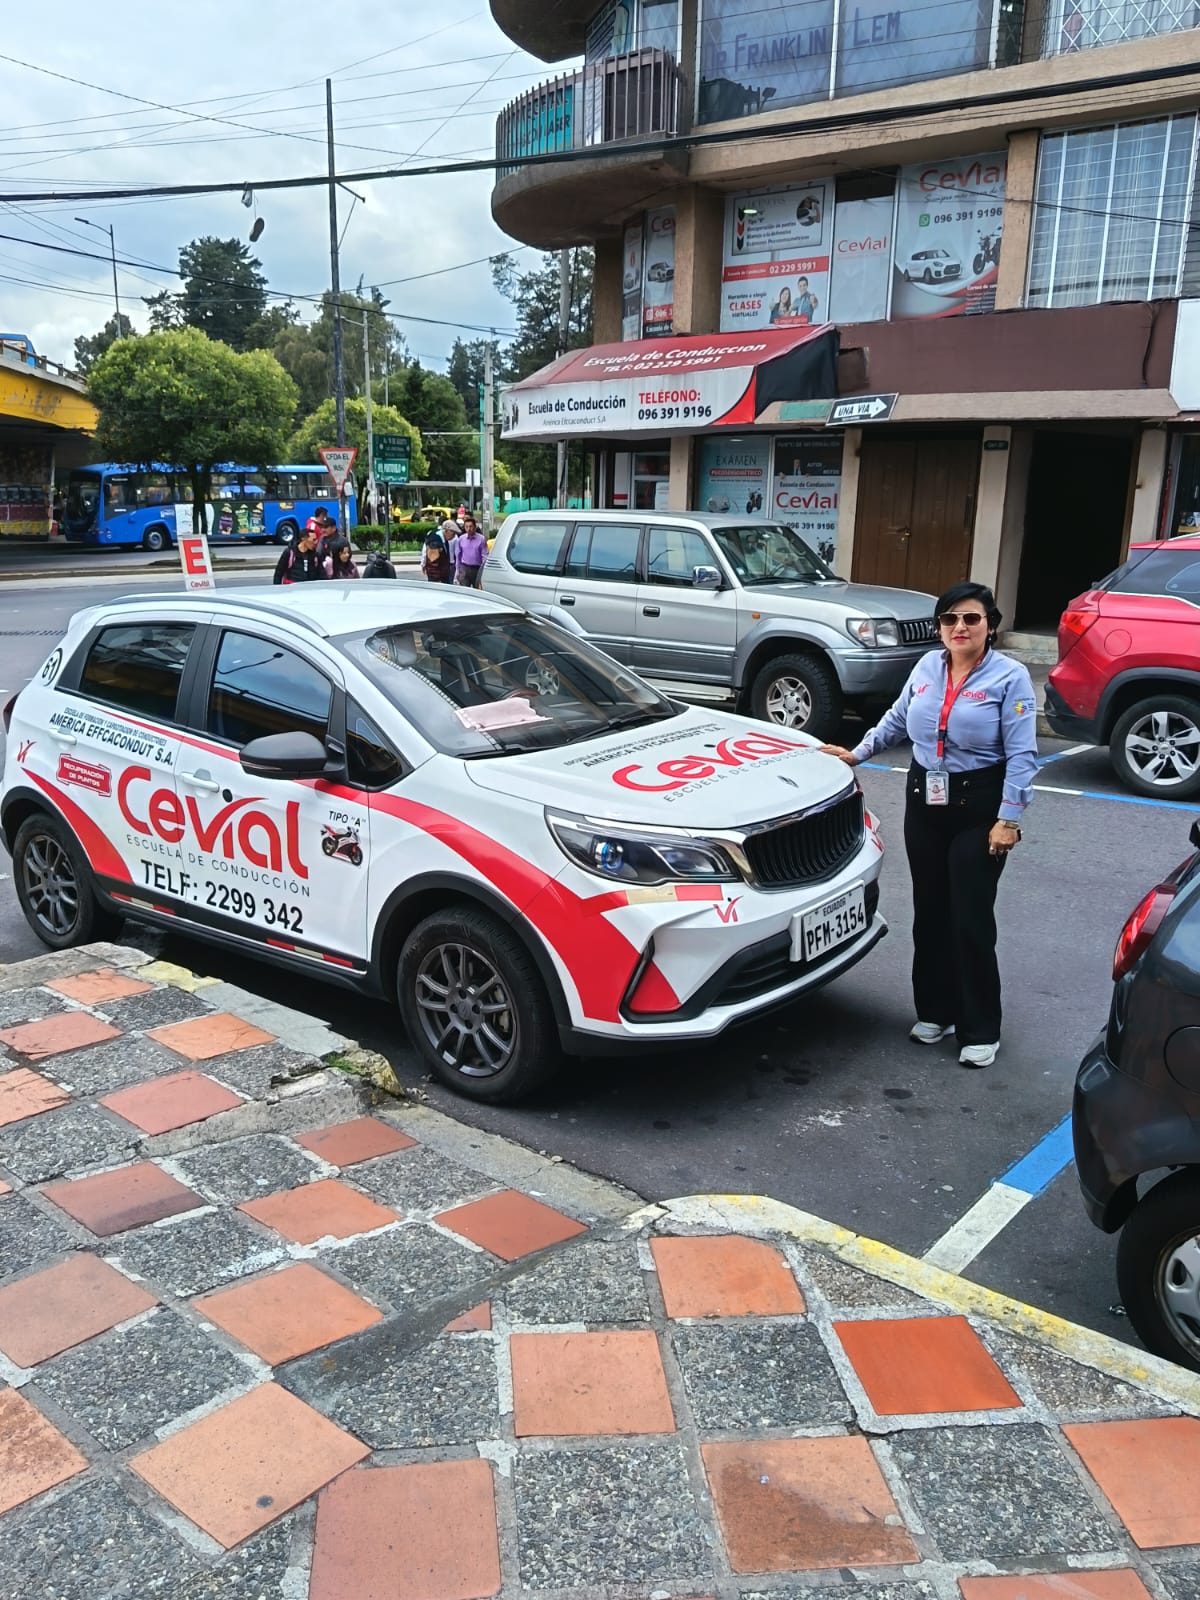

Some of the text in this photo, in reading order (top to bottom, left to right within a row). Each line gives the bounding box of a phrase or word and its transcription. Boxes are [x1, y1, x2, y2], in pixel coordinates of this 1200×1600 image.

[735, 28, 826, 72] FRANKLIN
[934, 207, 1003, 224] 096 391 9196
[838, 236, 887, 253] Cevial
[770, 261, 816, 274] 02 229 5991
[729, 300, 762, 311] CLASES
[584, 350, 640, 366] Escuela
[642, 350, 661, 360] de
[634, 362, 652, 370] 02
[653, 360, 682, 369] 229
[683, 356, 722, 367] 5991
[528, 394, 626, 415] Escuela de Conducción
[638, 405, 712, 420] 096 391 9196
[838, 405, 854, 417] UNA
[716, 455, 757, 466] EXAMEN
[776, 491, 838, 508] Cevial
[182, 539, 207, 574] E
[41, 657, 58, 680] 61
[49, 713, 87, 736] AMERICA
[155, 748, 173, 766] S.A.
[583, 749, 636, 767] AMERICA
[612, 732, 811, 792] Cevial
[77, 775, 100, 787] PUNTOS
[663, 773, 729, 803] ESCUELA
[729, 767, 749, 775] DE
[117, 765, 309, 880] Cevial
[329, 810, 366, 827] TIPO "A"
[126, 834, 311, 897] ESCUELA DE CONDUCCIÓN
[140, 859, 304, 934] TELF: 2299 342
[823, 897, 846, 916] ECUADOR
[806, 902, 864, 955] PFM-3154
